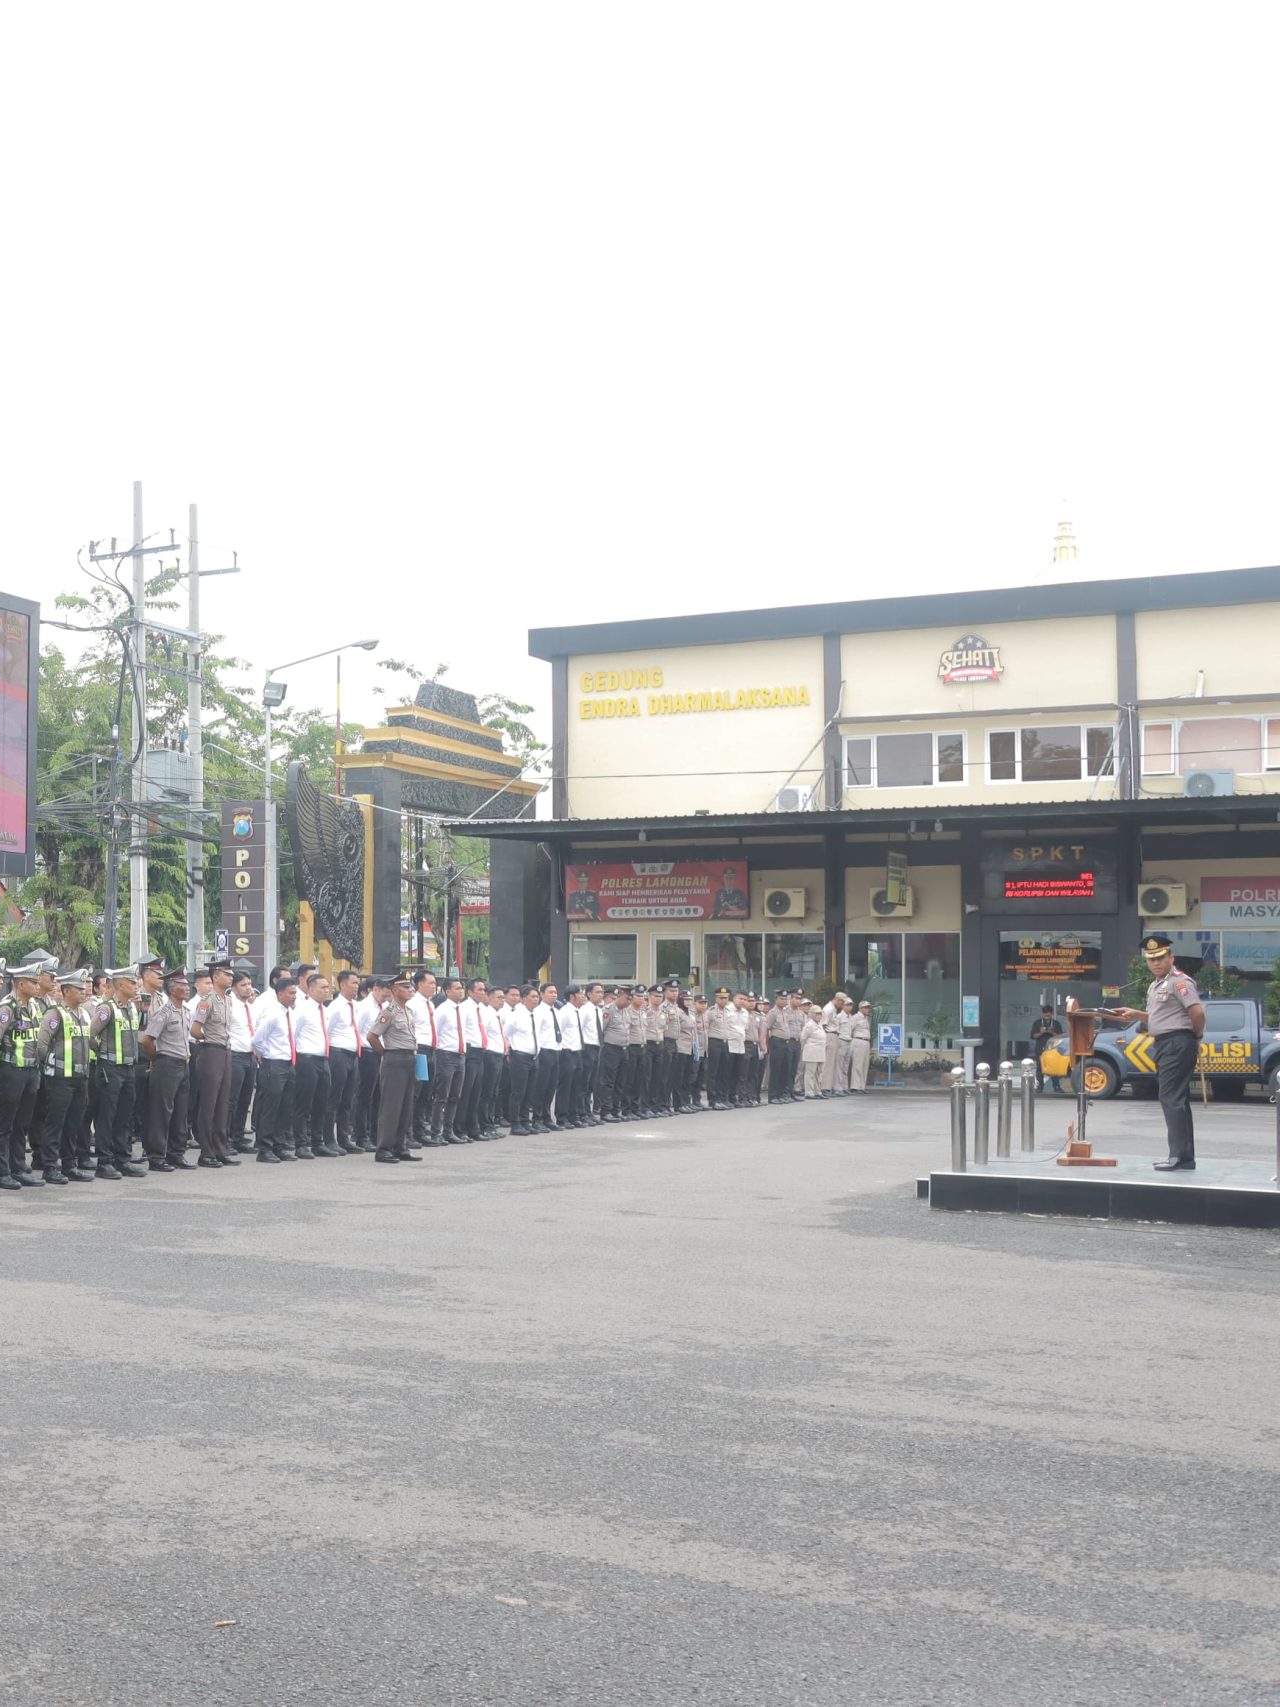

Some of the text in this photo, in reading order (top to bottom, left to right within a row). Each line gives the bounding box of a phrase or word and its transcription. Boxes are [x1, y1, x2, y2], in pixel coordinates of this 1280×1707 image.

[938, 648, 1004, 676] SEHATI
[579, 666, 664, 693] GEDUNG
[579, 685, 811, 720] ENDRA DHARMALAKSANA
[600, 876, 709, 889] POLRES LAMONGAN
[1230, 888, 1280, 902] POLR
[1018, 948, 1053, 956] PELAYANAN
[880, 1026, 893, 1043] P
[1199, 1041, 1252, 1057] OLISI
